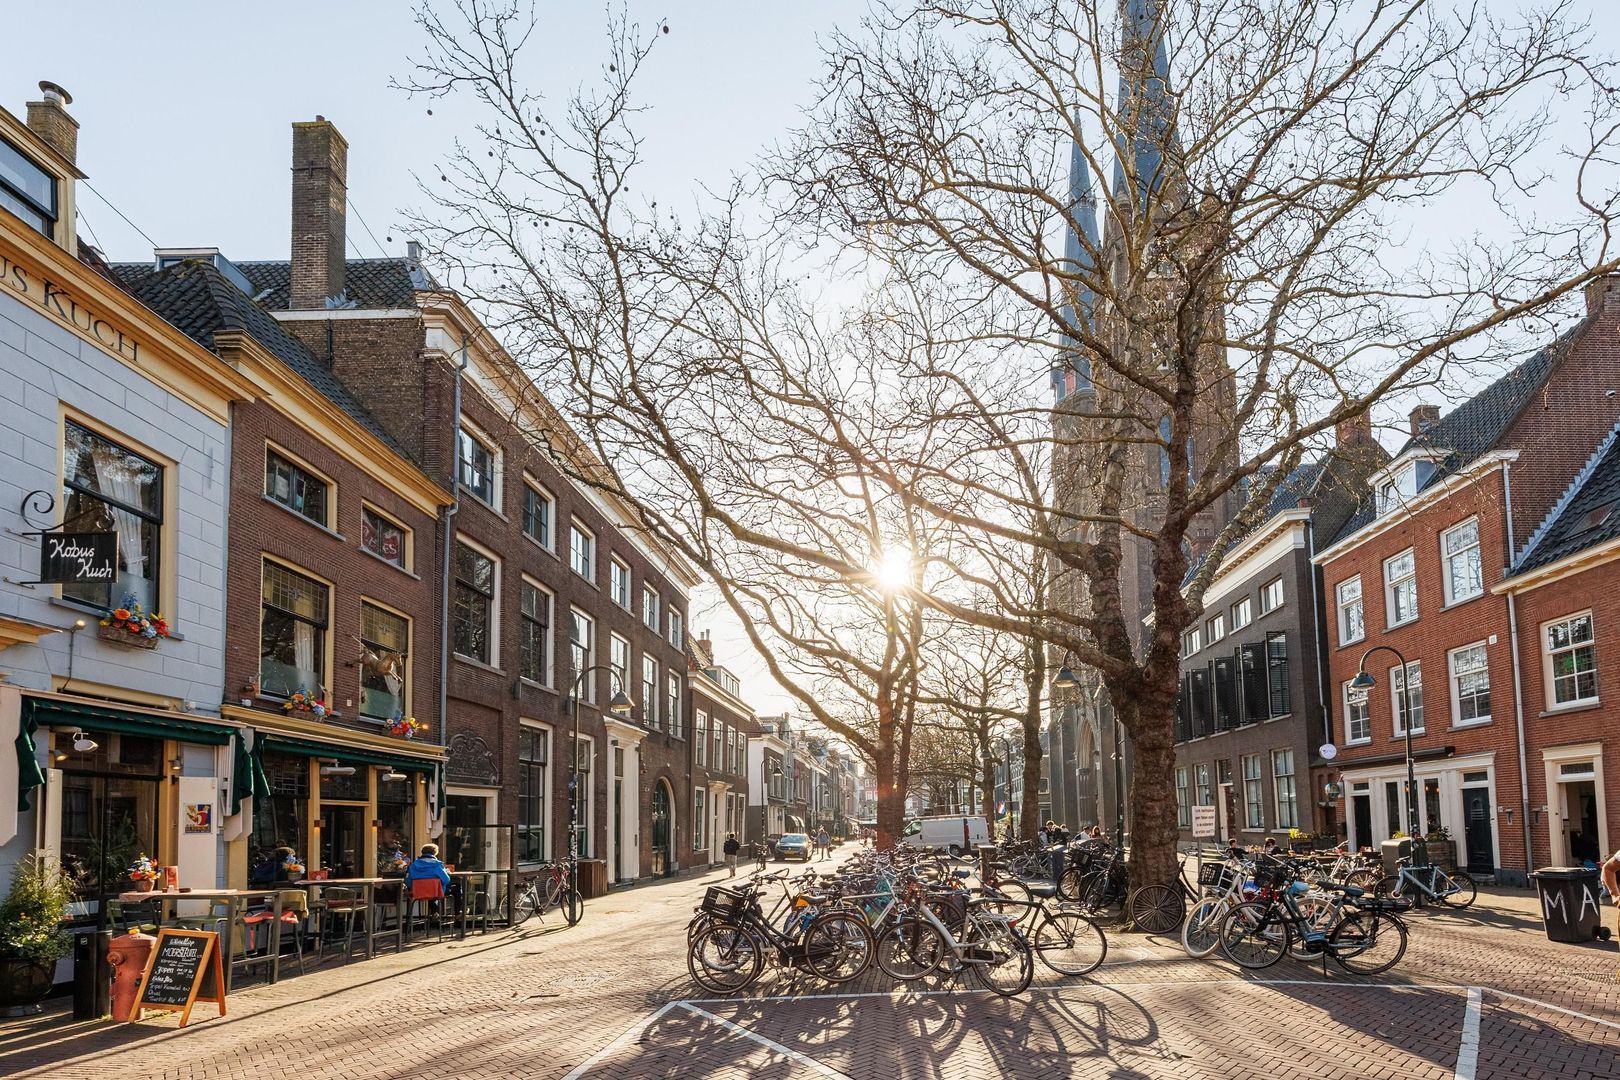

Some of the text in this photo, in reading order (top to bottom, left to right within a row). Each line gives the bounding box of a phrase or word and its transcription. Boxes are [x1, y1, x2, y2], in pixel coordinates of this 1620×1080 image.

[43, 277, 139, 362] KUCH
[49, 538, 95, 558] Kobus
[76, 558, 112, 578] Kuch
